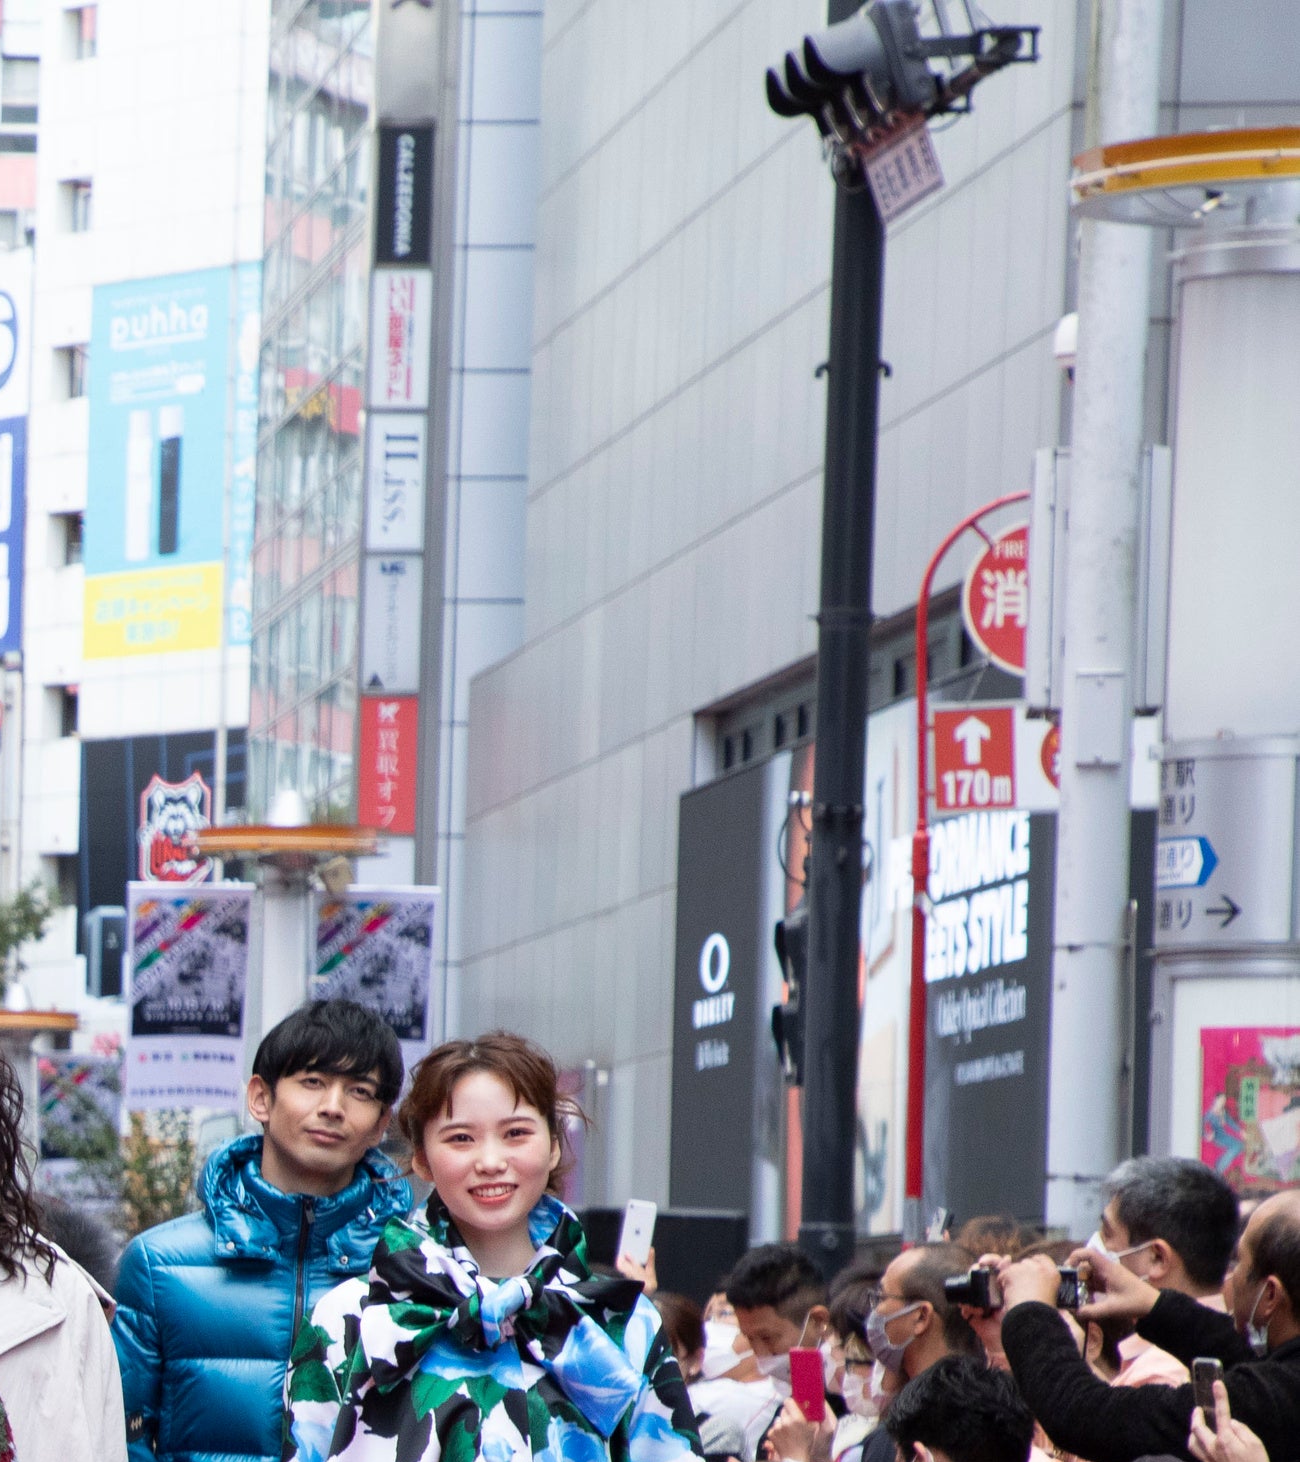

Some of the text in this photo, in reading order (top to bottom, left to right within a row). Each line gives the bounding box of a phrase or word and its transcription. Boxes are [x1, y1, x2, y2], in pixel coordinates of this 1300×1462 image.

[110, 300, 208, 351] puhha
[942, 768, 1012, 809] 170m
[967, 879, 1028, 975] STYLE
